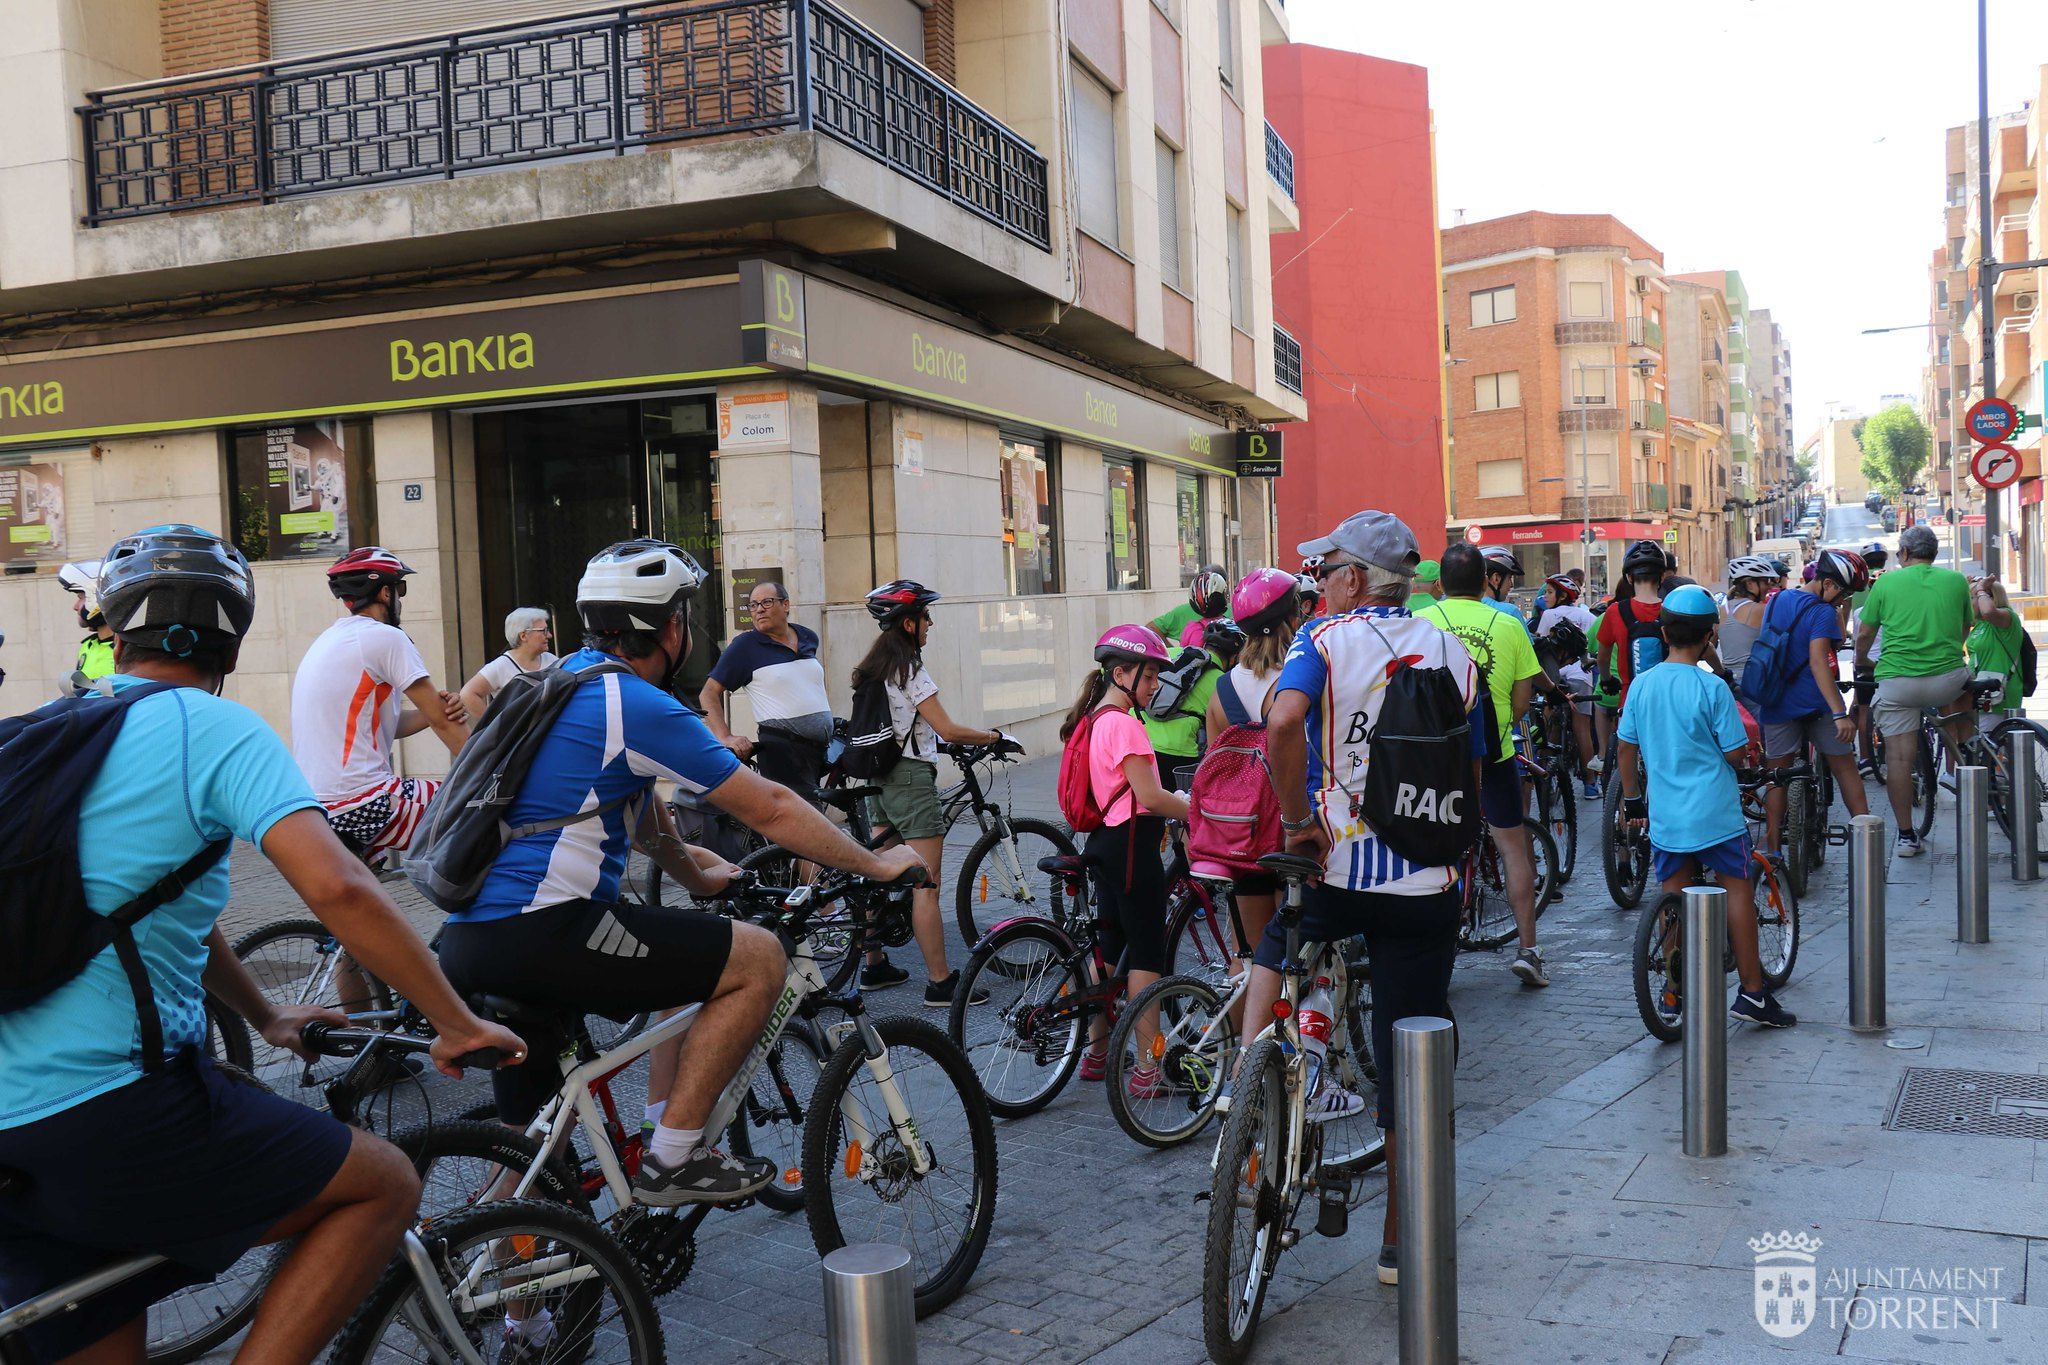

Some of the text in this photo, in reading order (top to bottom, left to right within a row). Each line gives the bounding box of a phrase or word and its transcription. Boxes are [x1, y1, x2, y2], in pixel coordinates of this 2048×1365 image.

[775, 273, 795, 322] B
[390, 332, 535, 382] Bankia
[912, 332, 968, 385] Bankia
[1085, 391, 1118, 428] Bankia
[1976, 412, 2006, 421] AMBOS
[742, 425, 775, 436] Colom
[1977, 421, 2006, 429] LADOS
[1188, 426, 1211, 456] Bankia
[1249, 434, 1268, 457] B
[1252, 464, 1278, 474] ServiRed
[407, 486, 420, 499] 22
[672, 535, 722, 549] ankia
[1512, 530, 1544, 540] ferrandis
[1108, 636, 1135, 650] KIDDY
[499, 1145, 564, 1192] HUTCNSON
